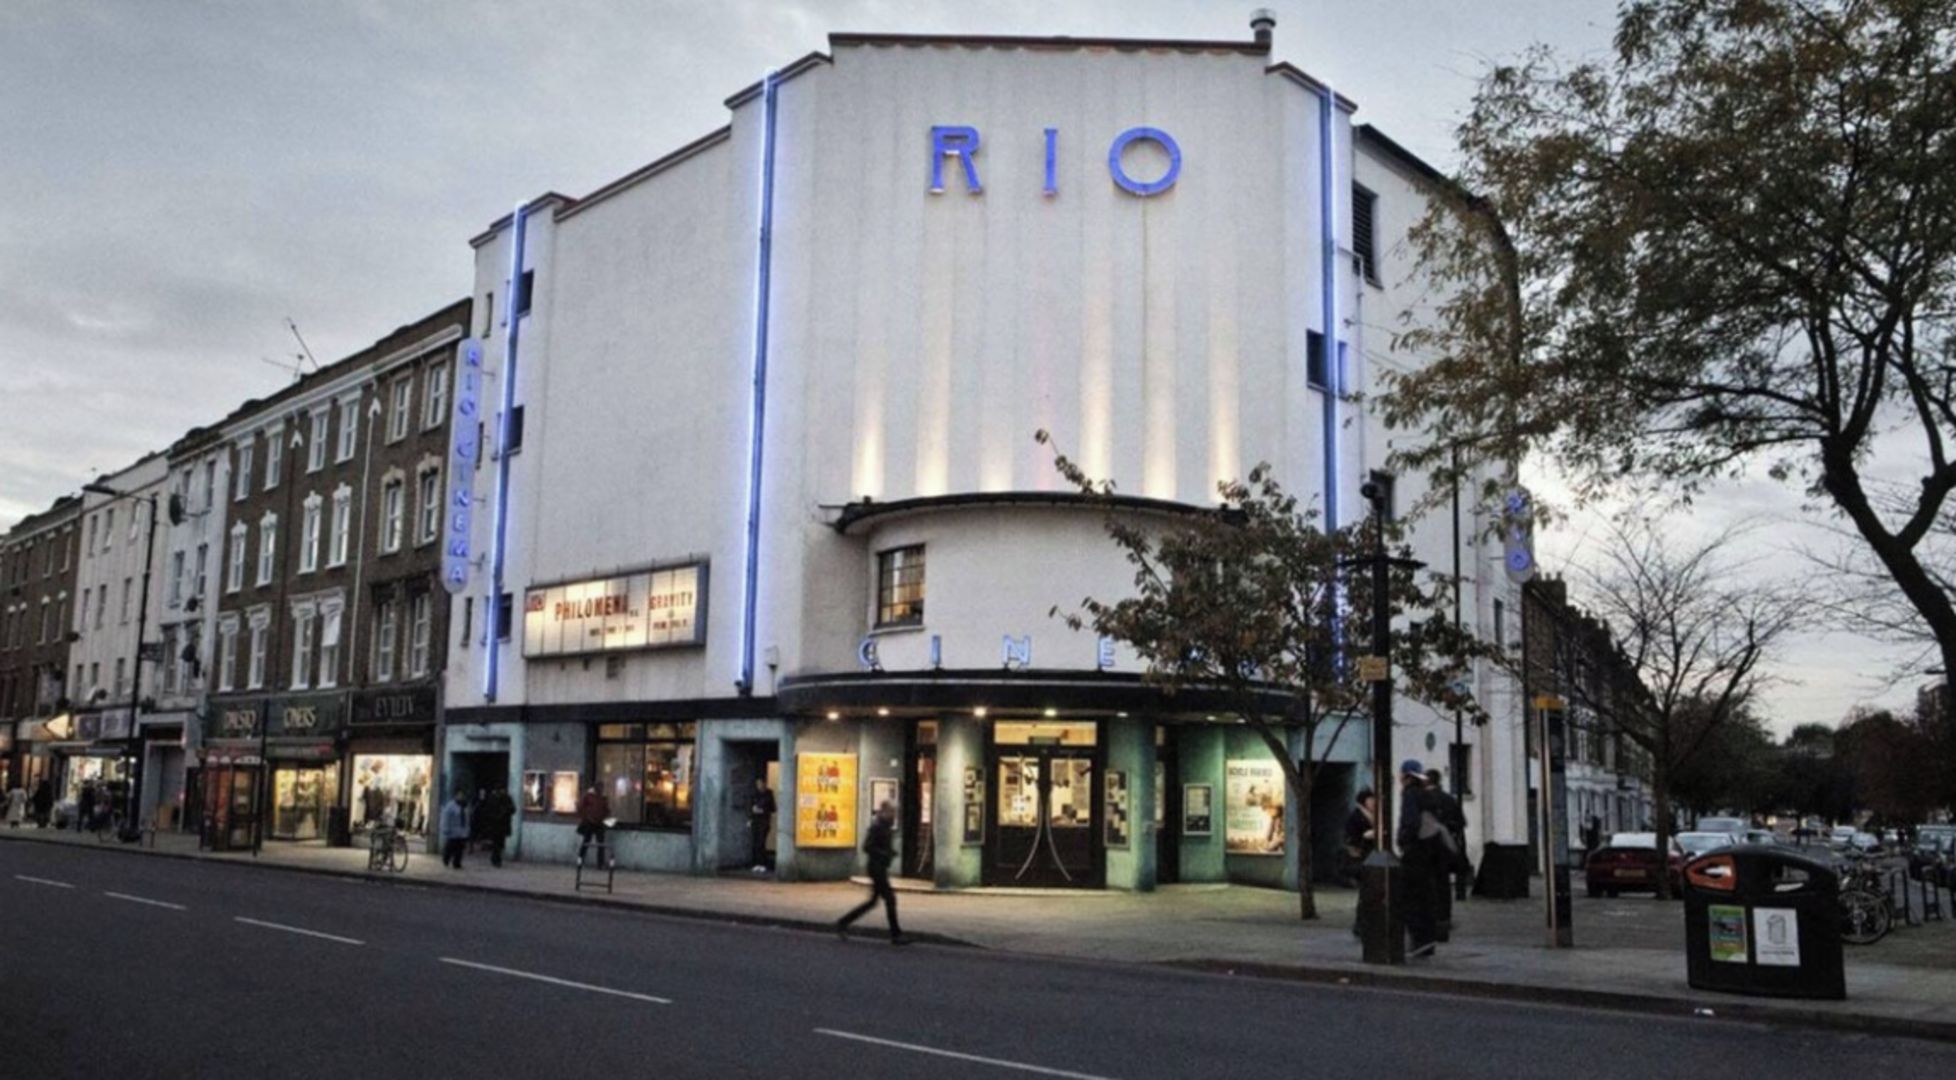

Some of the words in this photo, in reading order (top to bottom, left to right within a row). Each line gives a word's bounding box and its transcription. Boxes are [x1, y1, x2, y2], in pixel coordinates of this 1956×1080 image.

[929, 125, 1183, 197] RIO
[457, 347, 481, 417] RIO
[448, 441, 475, 584] CINEMA
